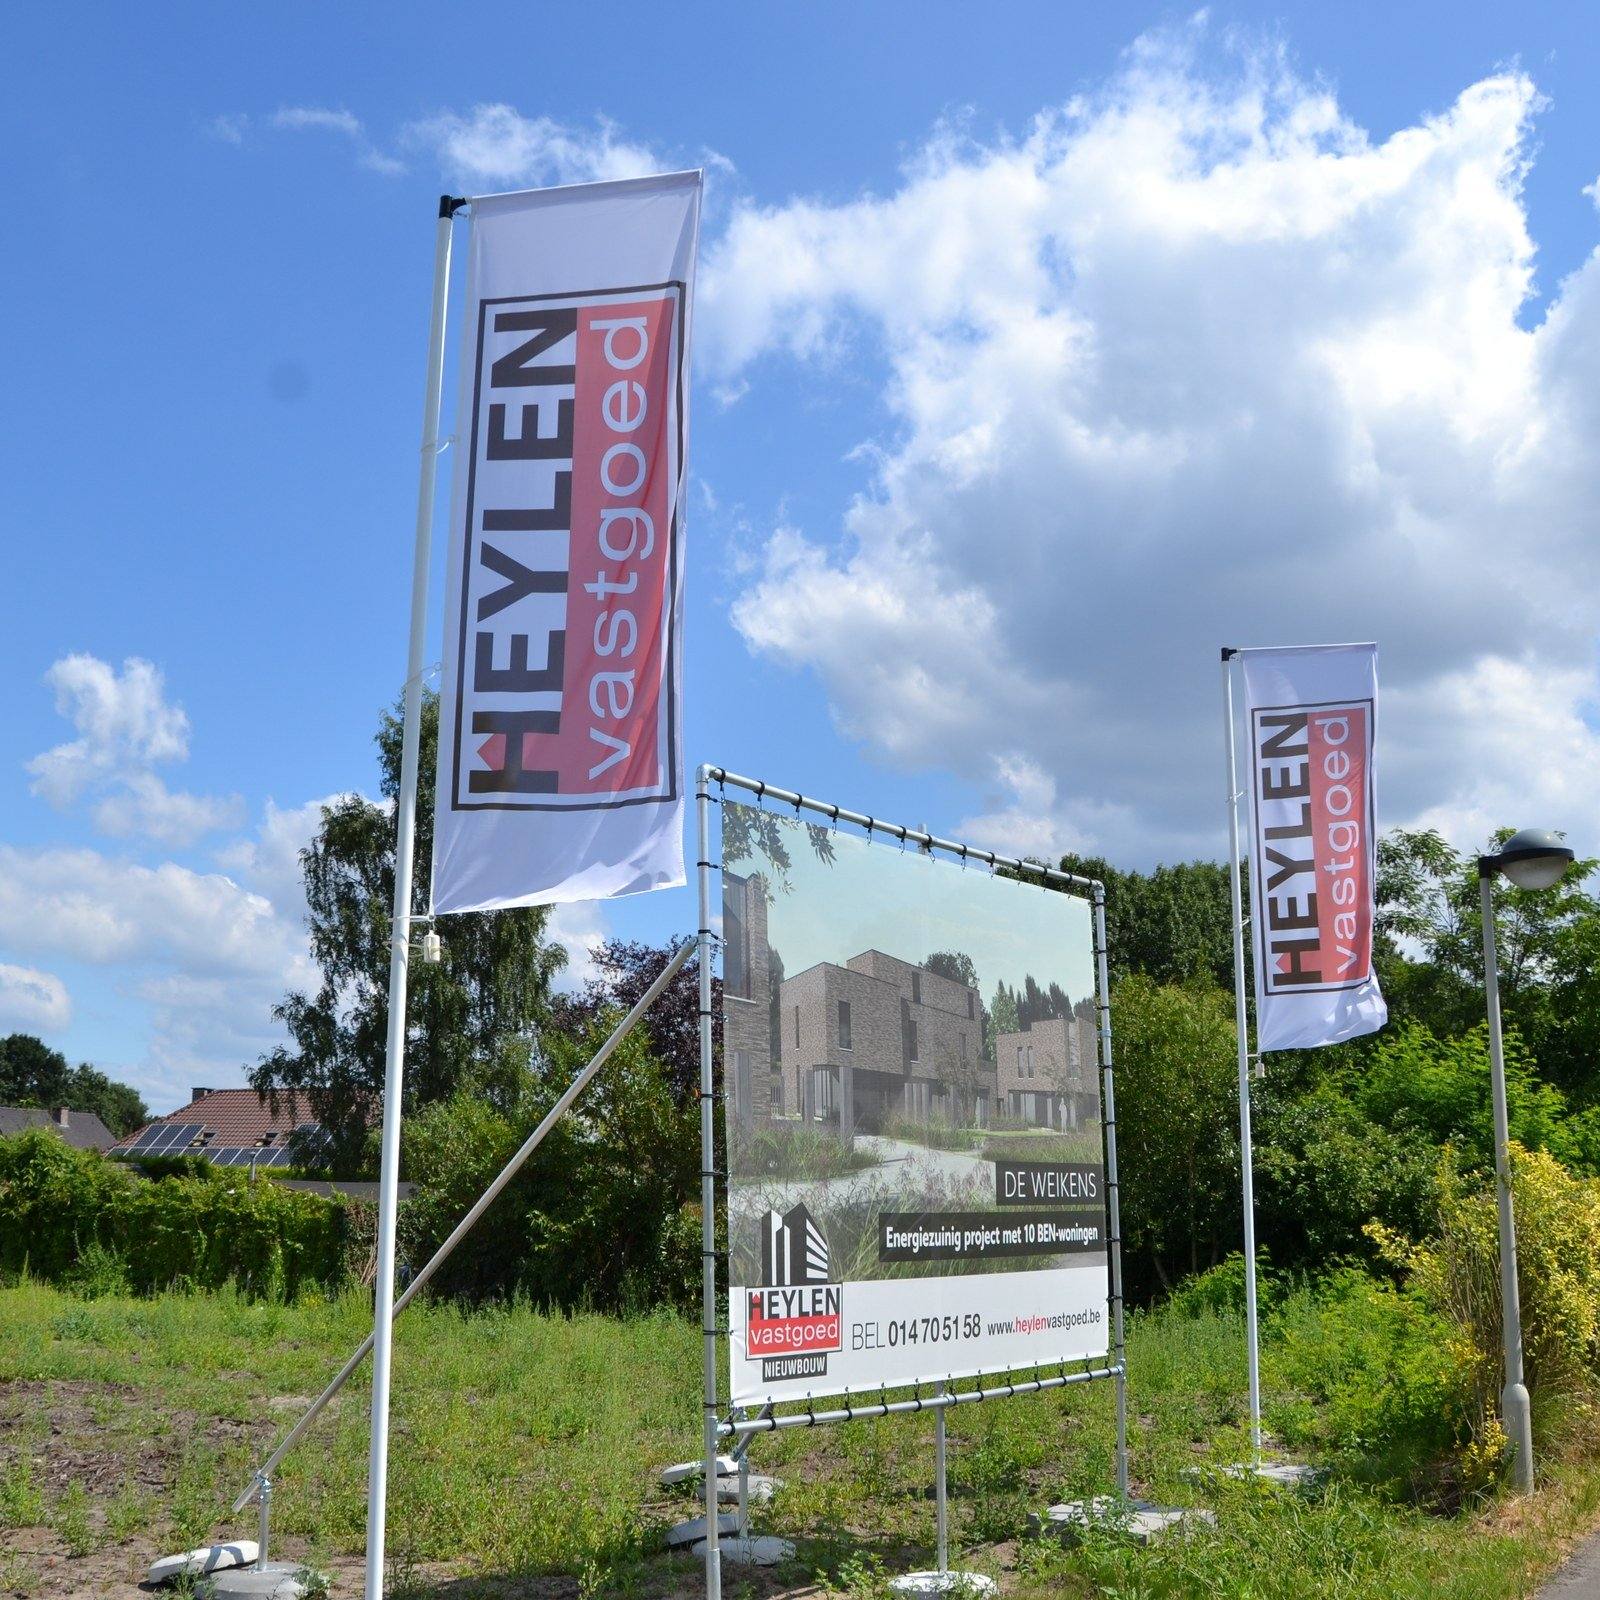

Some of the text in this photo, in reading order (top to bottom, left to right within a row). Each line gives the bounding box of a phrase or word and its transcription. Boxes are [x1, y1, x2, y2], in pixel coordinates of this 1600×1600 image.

[469, 307, 578, 795] HEYLEN
[583, 315, 655, 782] vastgoed
[1260, 712, 1323, 987] HEYLEN
[1314, 715, 1361, 975] vastgoed
[1004, 1171, 1097, 1198] DE WEIKENS
[886, 1222, 1098, 1253] Energiezuinig project met 10 BEN-woningen
[748, 1287, 841, 1321] HEYLEN
[750, 1320, 838, 1347] vastgoed
[852, 1322, 886, 1351] BEL
[987, 1308, 1101, 1336] www.heylenvastgoed.be
[764, 1356, 826, 1377] NIEUWBOUW
